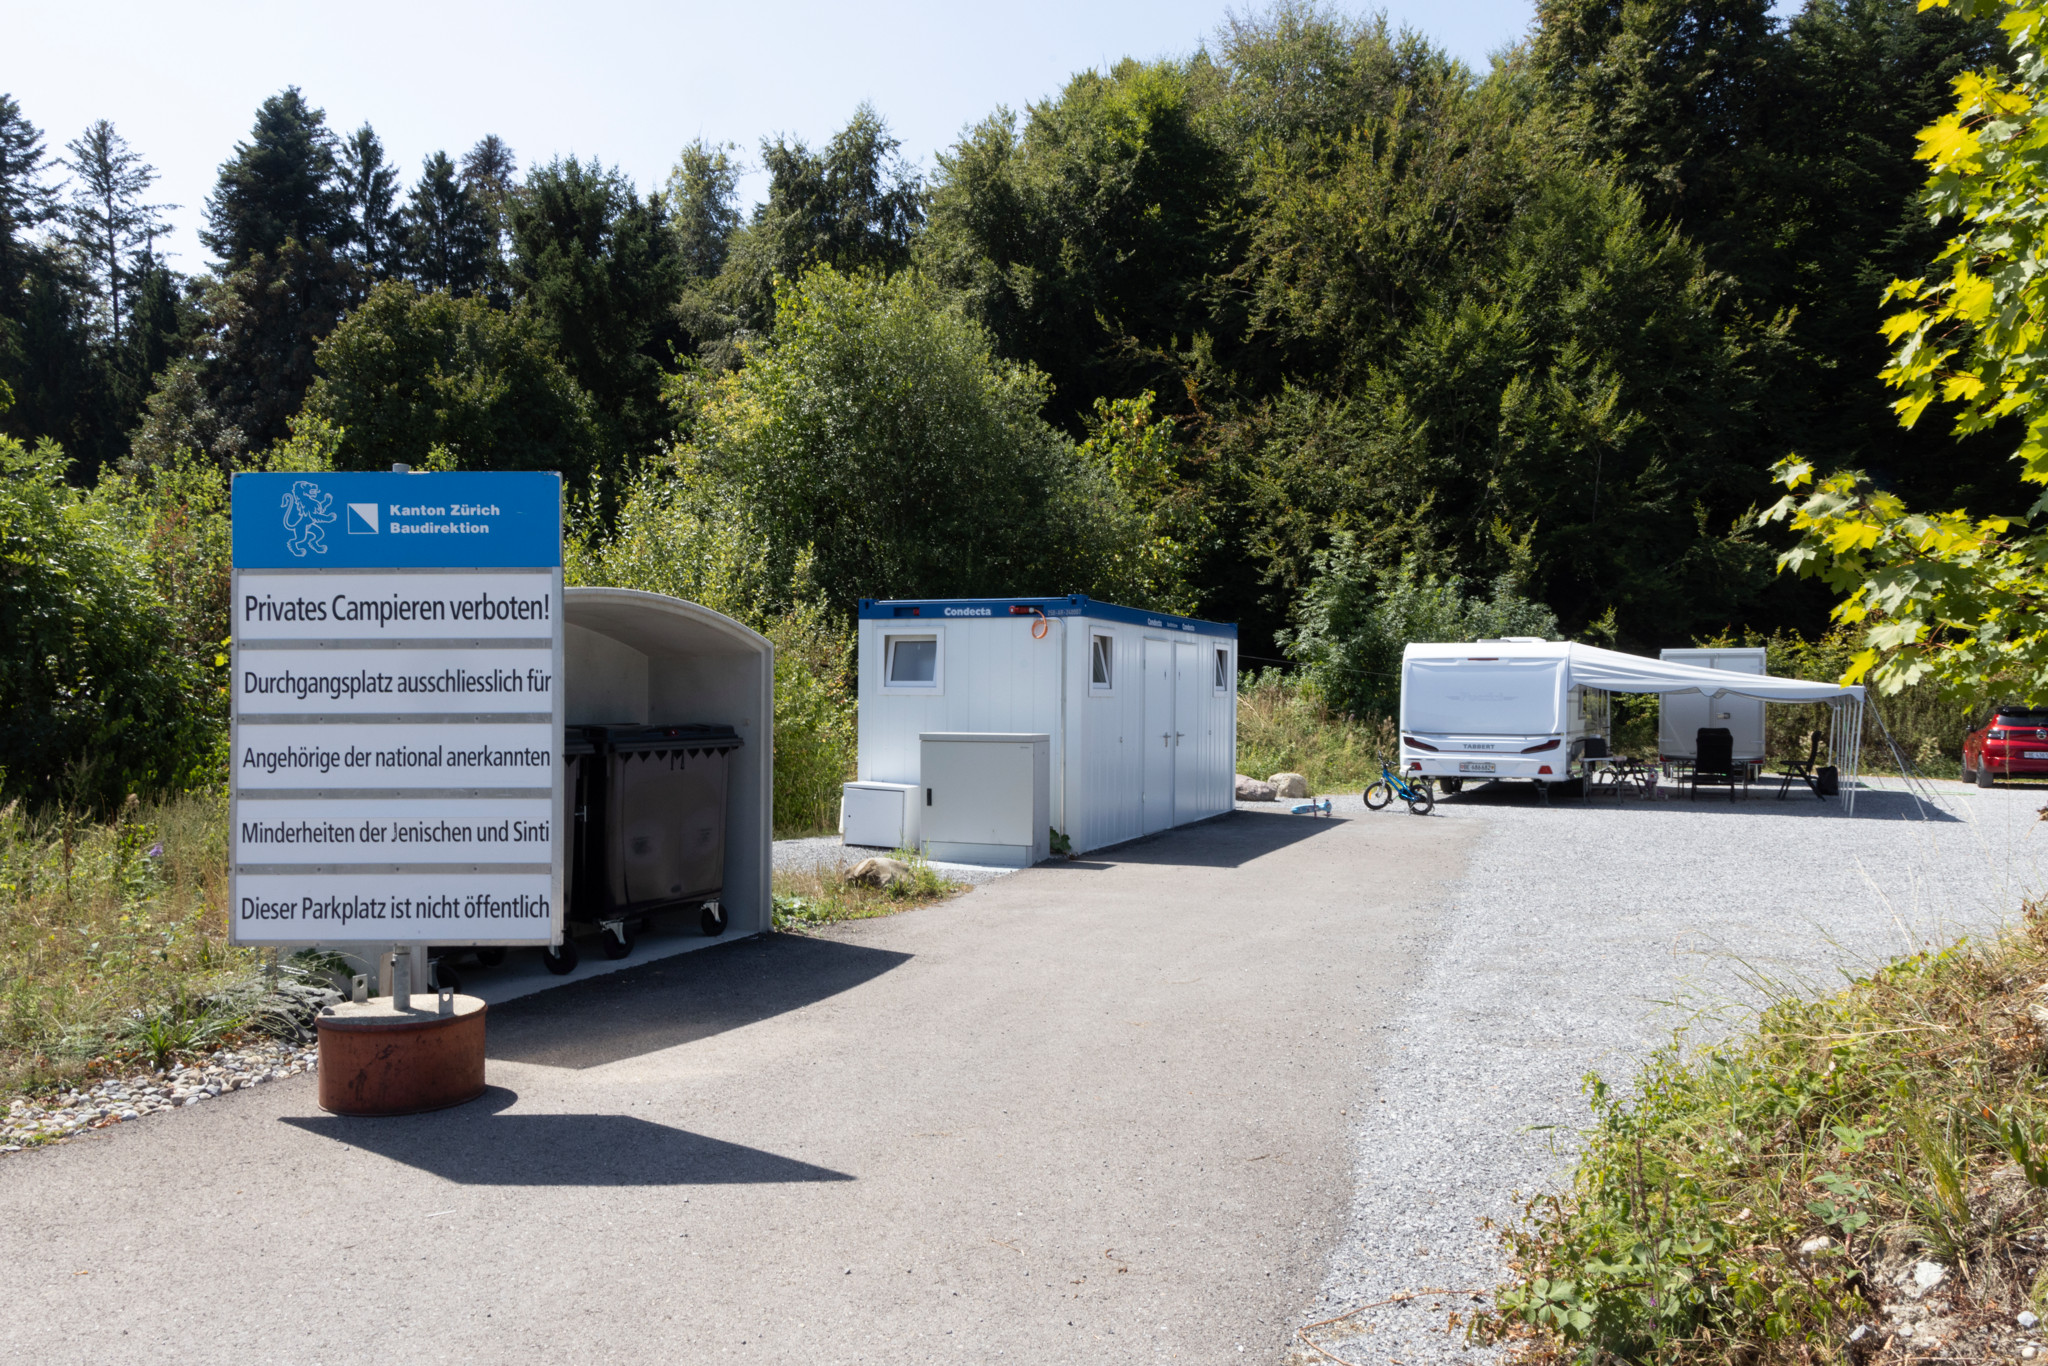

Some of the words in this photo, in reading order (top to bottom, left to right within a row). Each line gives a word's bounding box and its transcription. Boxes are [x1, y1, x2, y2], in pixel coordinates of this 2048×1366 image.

[390, 504, 446, 516] Kanton
[450, 504, 500, 516] Zürich
[390, 522, 489, 534] Baudirektion
[245, 594, 328, 622] Privates
[331, 593, 445, 629] Campieren
[449, 591, 549, 621] verboten!
[944, 607, 992, 616] Condecta
[244, 669, 393, 700] Durchgangsplatz
[397, 668, 523, 693] ausschliesslich
[526, 667, 552, 693] für
[242, 745, 341, 774] Angehörige
[344, 745, 372, 768] der
[375, 744, 443, 768] national
[446, 744, 551, 767] anerkannten
[242, 820, 355, 844] Minderheiten
[359, 820, 388, 843] der
[390, 820, 472, 843] Jenischen
[476, 819, 509, 843] und
[513, 820, 550, 843] Sinti
[241, 896, 298, 920] Dieser
[302, 894, 387, 926] Parkplatz
[390, 895, 412, 919] ist
[415, 894, 461, 919] nicht
[463, 893, 550, 919] öffentlich
